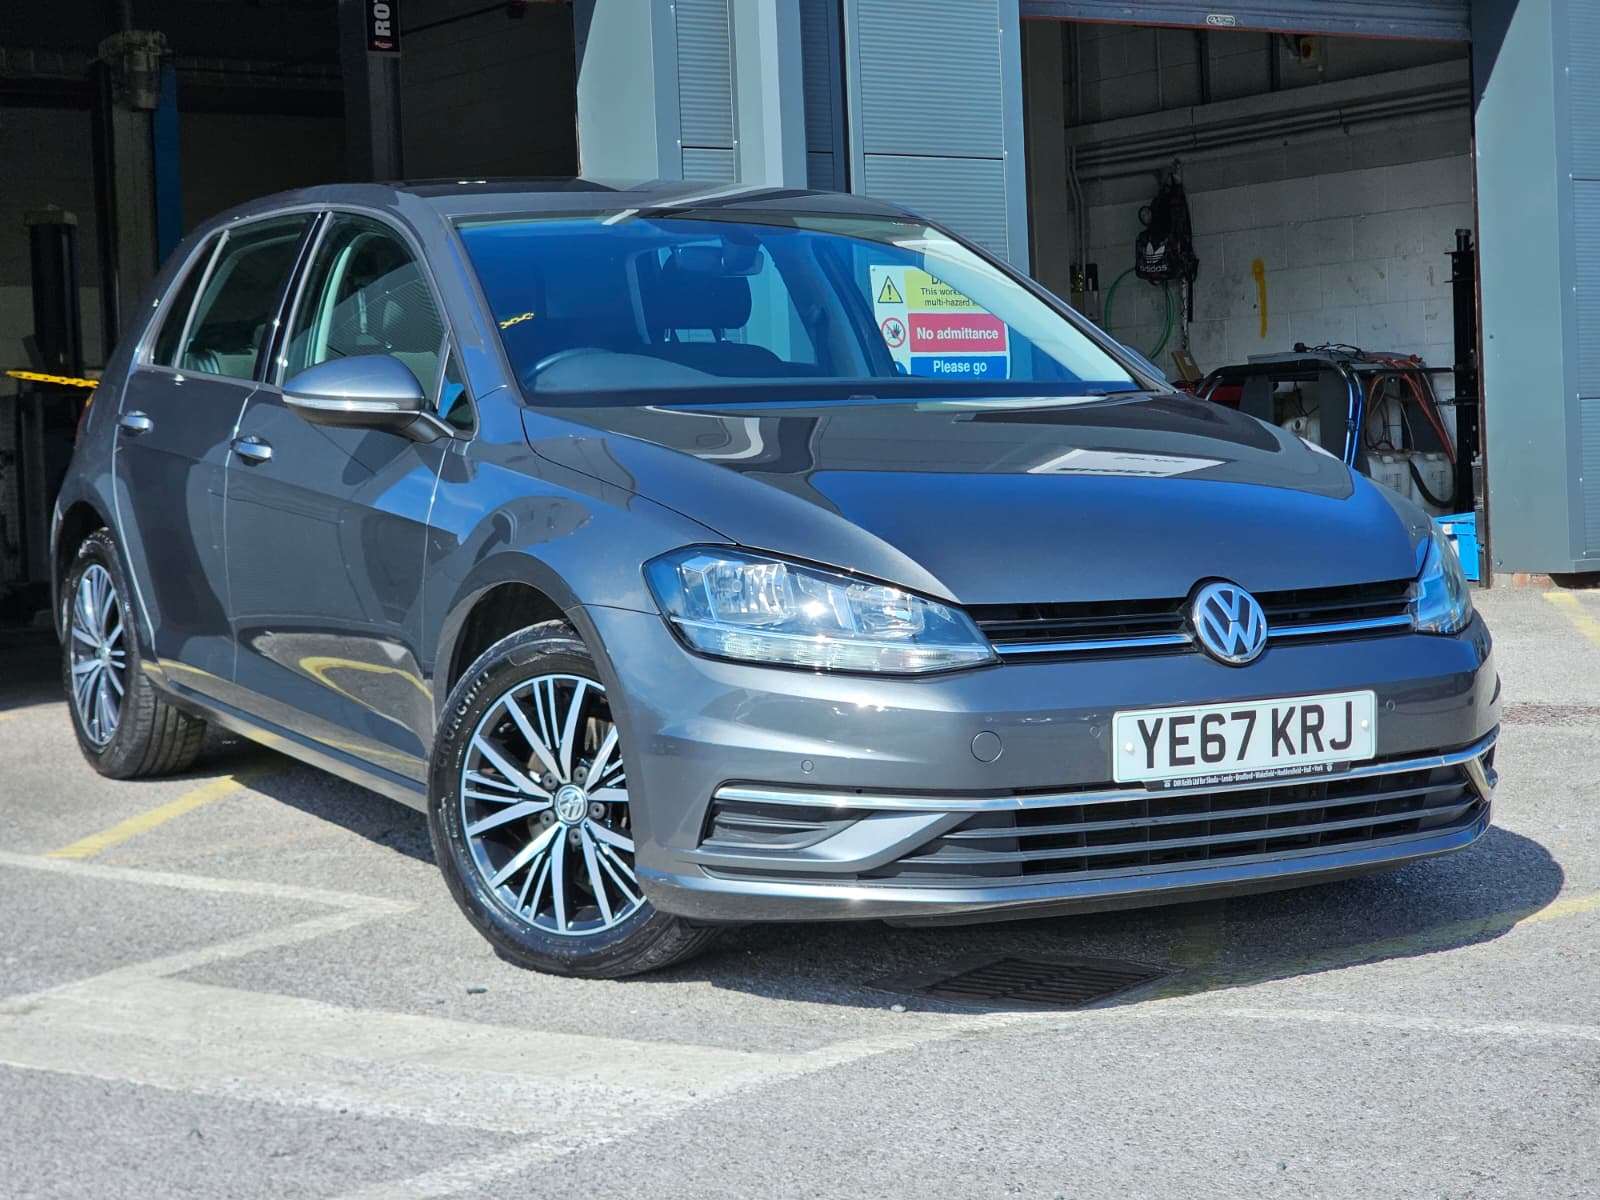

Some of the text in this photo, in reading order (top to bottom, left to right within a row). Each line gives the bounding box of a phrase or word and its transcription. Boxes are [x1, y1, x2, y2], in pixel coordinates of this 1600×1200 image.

[373, 0, 391, 37] RO
[1139, 264, 1168, 273] adidas
[920, 287, 938, 296] This
[924, 298, 970, 307] multi-hazard
[916, 326, 999, 340] No admittance
[933, 359, 988, 375] Please go
[1194, 584, 1266, 661] VW
[1136, 701, 1353, 769] YE67 KRJ
